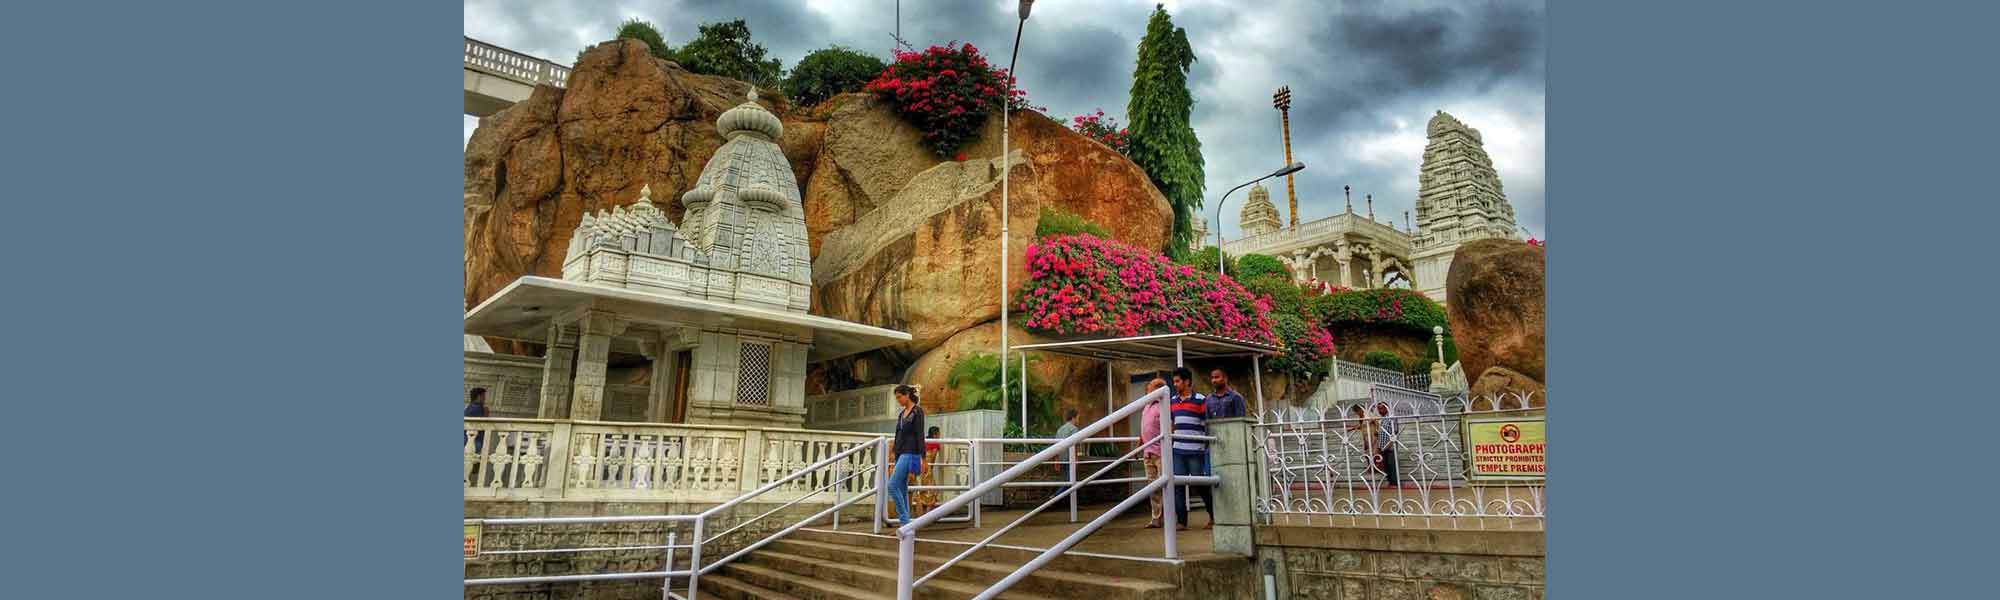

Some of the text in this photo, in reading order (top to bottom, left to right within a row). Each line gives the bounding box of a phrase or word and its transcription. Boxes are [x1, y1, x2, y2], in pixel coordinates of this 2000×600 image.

[1475, 444, 1546, 454] PHOTOGRAPH
[1477, 464, 1546, 472] TEMPLE PREMIS
